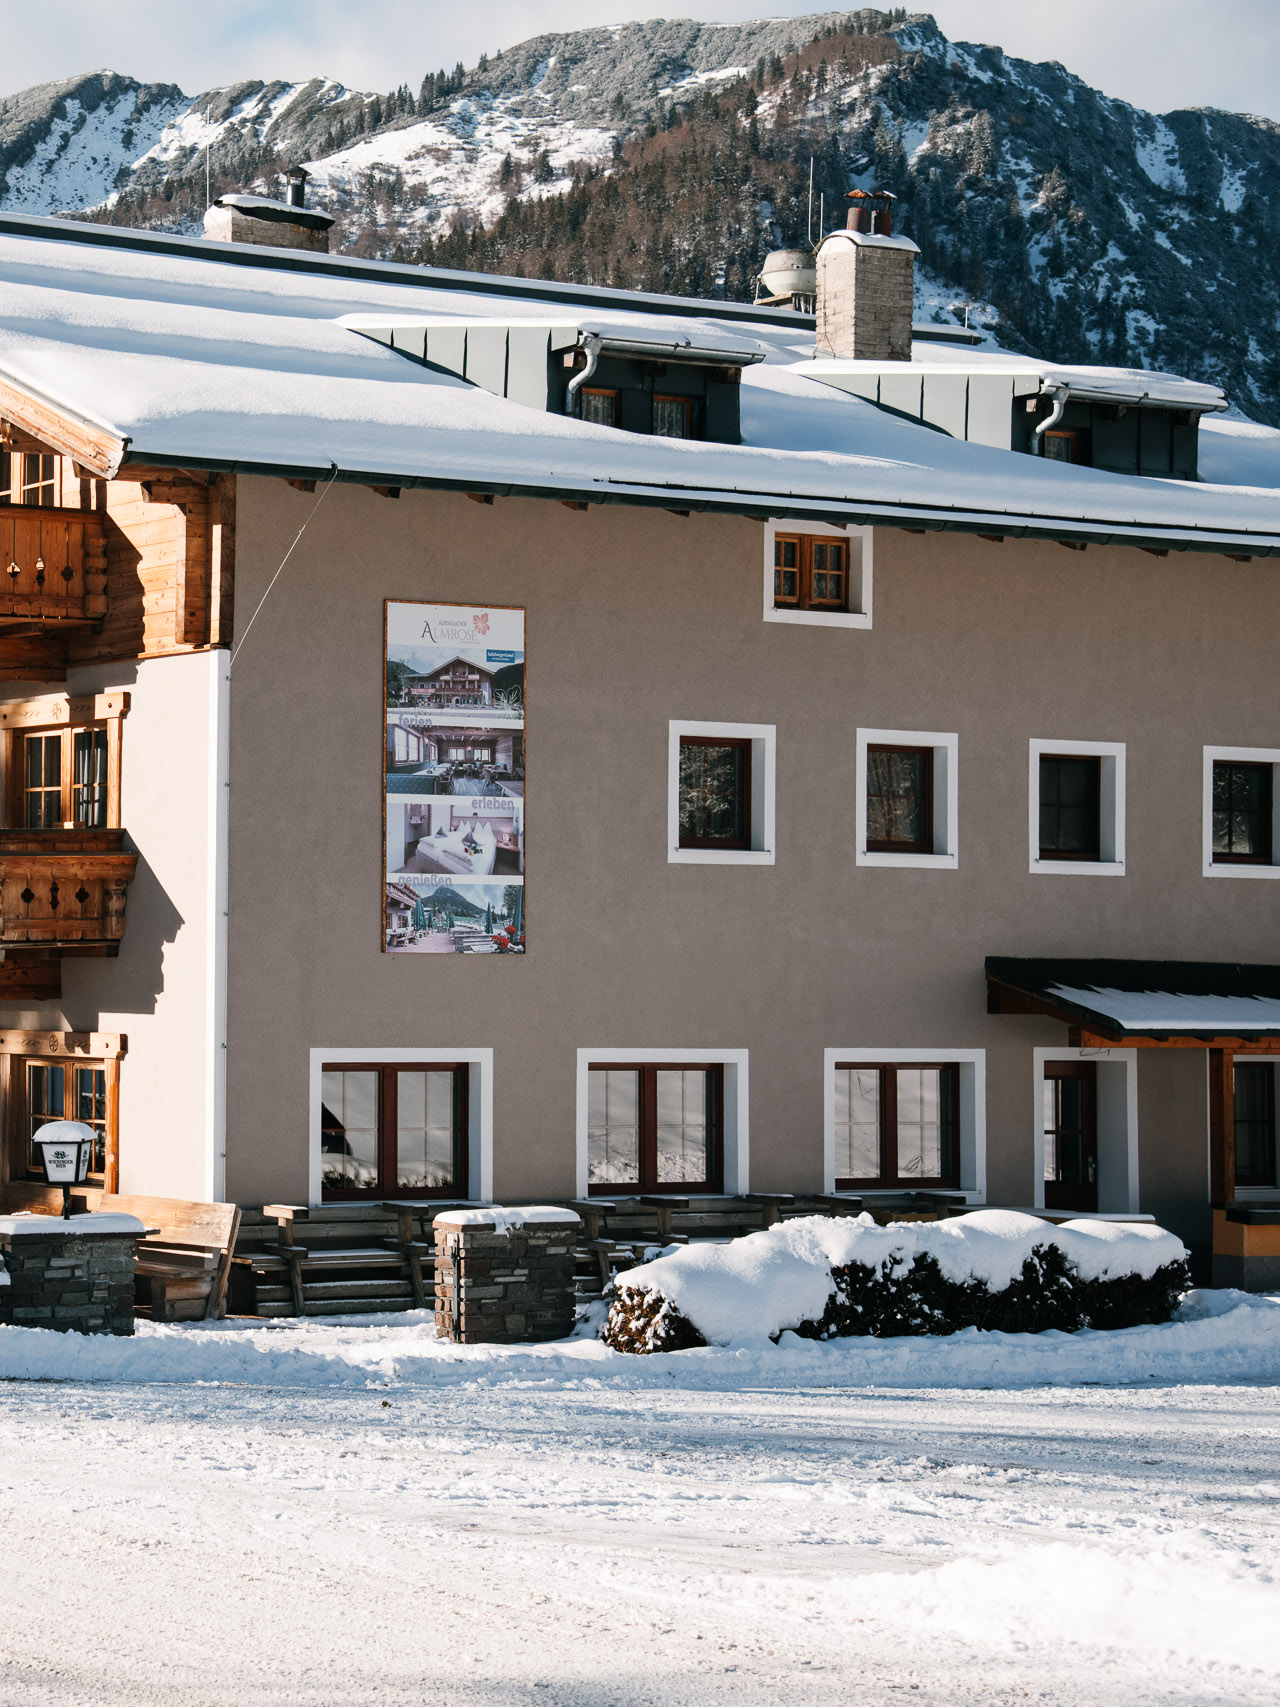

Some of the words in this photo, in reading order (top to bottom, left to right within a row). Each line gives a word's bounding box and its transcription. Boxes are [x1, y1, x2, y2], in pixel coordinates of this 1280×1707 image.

[421, 620, 478, 644] ALMROSE
[398, 712, 433, 728] ferien
[471, 796, 514, 810] erleben
[398, 873, 452, 889] genießen
